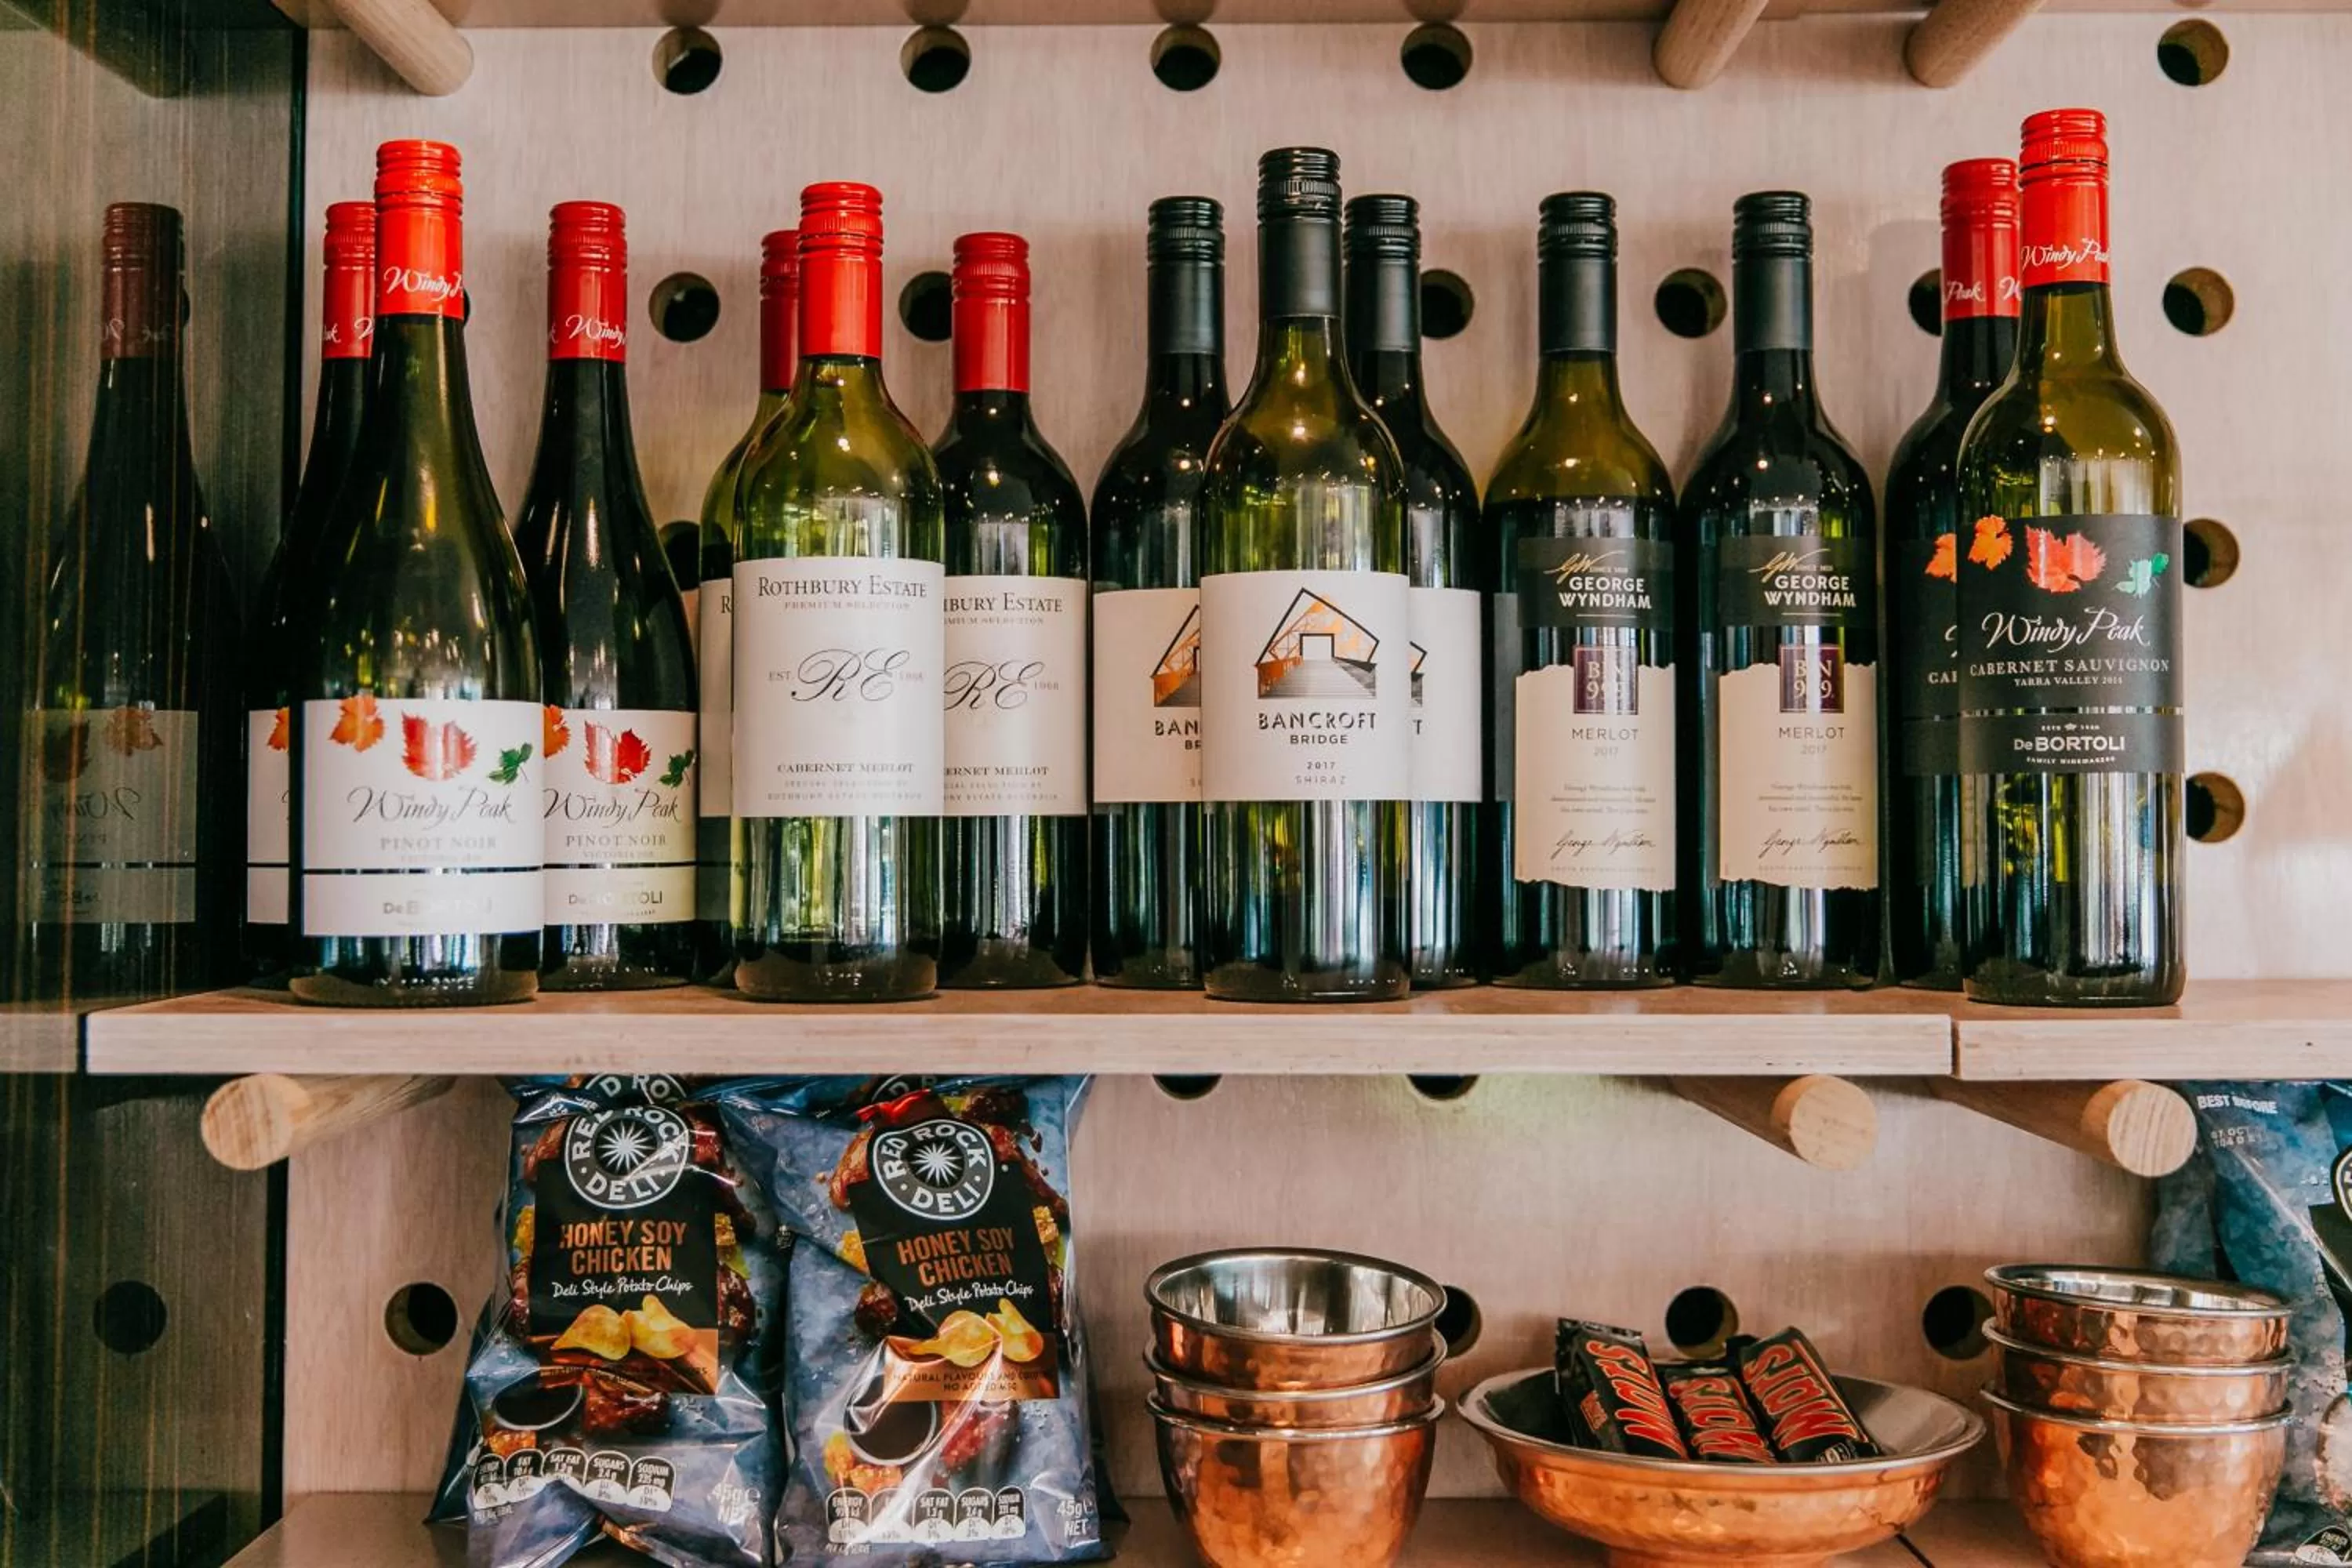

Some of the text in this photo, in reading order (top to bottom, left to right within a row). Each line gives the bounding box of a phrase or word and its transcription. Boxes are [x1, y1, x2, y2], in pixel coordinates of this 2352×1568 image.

[2021, 243, 2077, 270] Windy
[383, 266, 451, 302] Windy
[758, 575, 927, 597] ROTHBURY ESTATE
[1569, 576, 1645, 593] GEORGE
[1774, 575, 1849, 590] GEORGE
[943, 592, 1063, 612] BURY ESTATE
[1558, 592, 1652, 609] WYNDHAM
[1764, 590, 1857, 608] WYNDHAM
[1981, 612, 2076, 653] Windy
[2076, 606, 2151, 647] Peak
[1794, 659, 1832, 677] BN
[1969, 659, 2169, 677] CABERNET SAUVIGNON
[1793, 680, 1832, 699] 99
[2014, 677, 2051, 687] YARRA
[1258, 712, 1376, 730] BANCROFT
[1290, 735, 1349, 744] BRIDGE
[1572, 728, 1639, 741] MERLOT
[1779, 727, 1845, 740] MERLOT
[777, 763, 914, 773] CABERNET MERLOT
[944, 766, 1049, 775] ERNET MERLOT
[1306, 761, 1336, 770] 2017
[1295, 775, 1347, 785] SHIRAZ
[347, 786, 517, 830] Windy Peak
[543, 786, 681, 829] Windy Peak
[379, 837, 497, 851] PINOT NOIR
[565, 834, 666, 848] PINOT NOIR
[2197, 1094, 2279, 1114] BEST BEFORE
[881, 1123, 987, 1180] RED ROCK
[585, 1171, 662, 1202] DELI
[911, 1181, 981, 1213] DELI
[559, 1219, 688, 1250] HONEY SOY
[896, 1227, 1014, 1265] HONEY SOY
[572, 1246, 672, 1276] CHICKEN
[918, 1251, 1014, 1287] CHICKEN
[551, 1275, 694, 1299] Deli Style Potato Chips
[904, 1279, 1035, 1312] Deli Style Potato Chips
[1742, 1343, 1860, 1452] Mars
[550, 1454, 582, 1465] SAT FAT
[593, 1457, 626, 1471] SUGARS
[637, 1463, 670, 1476] SODIUM
[920, 1497, 935, 1508] SAT
[1056, 1500, 1083, 1519] 45g
[1064, 1519, 1090, 1538] NET
